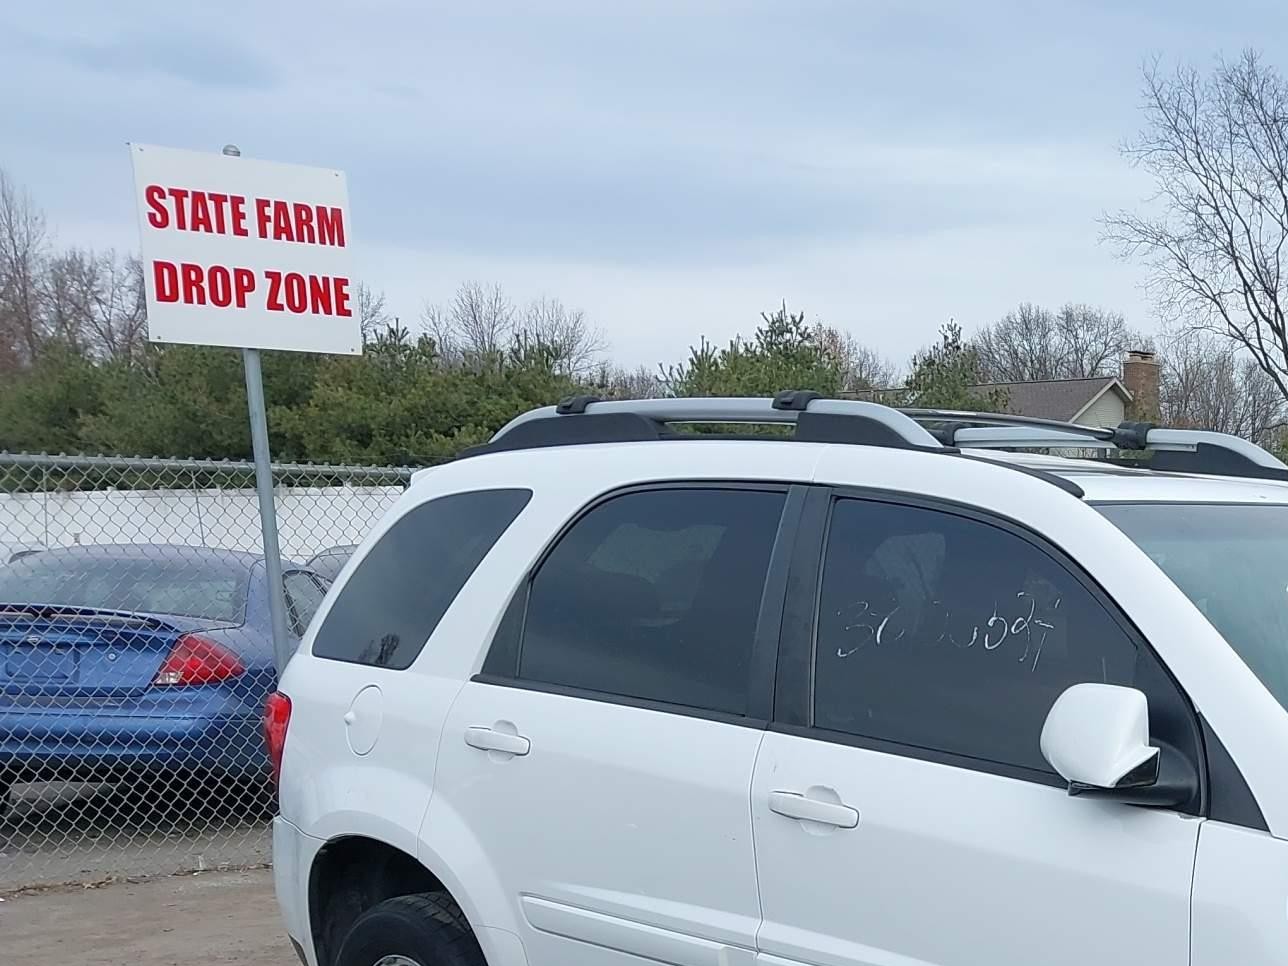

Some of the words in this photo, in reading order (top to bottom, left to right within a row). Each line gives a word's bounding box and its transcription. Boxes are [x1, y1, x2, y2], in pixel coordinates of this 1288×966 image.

[145, 184, 249, 238] STATE
[255, 198, 346, 248] FARM
[152, 260, 256, 309] DROP
[265, 271, 353, 318] ZONE
